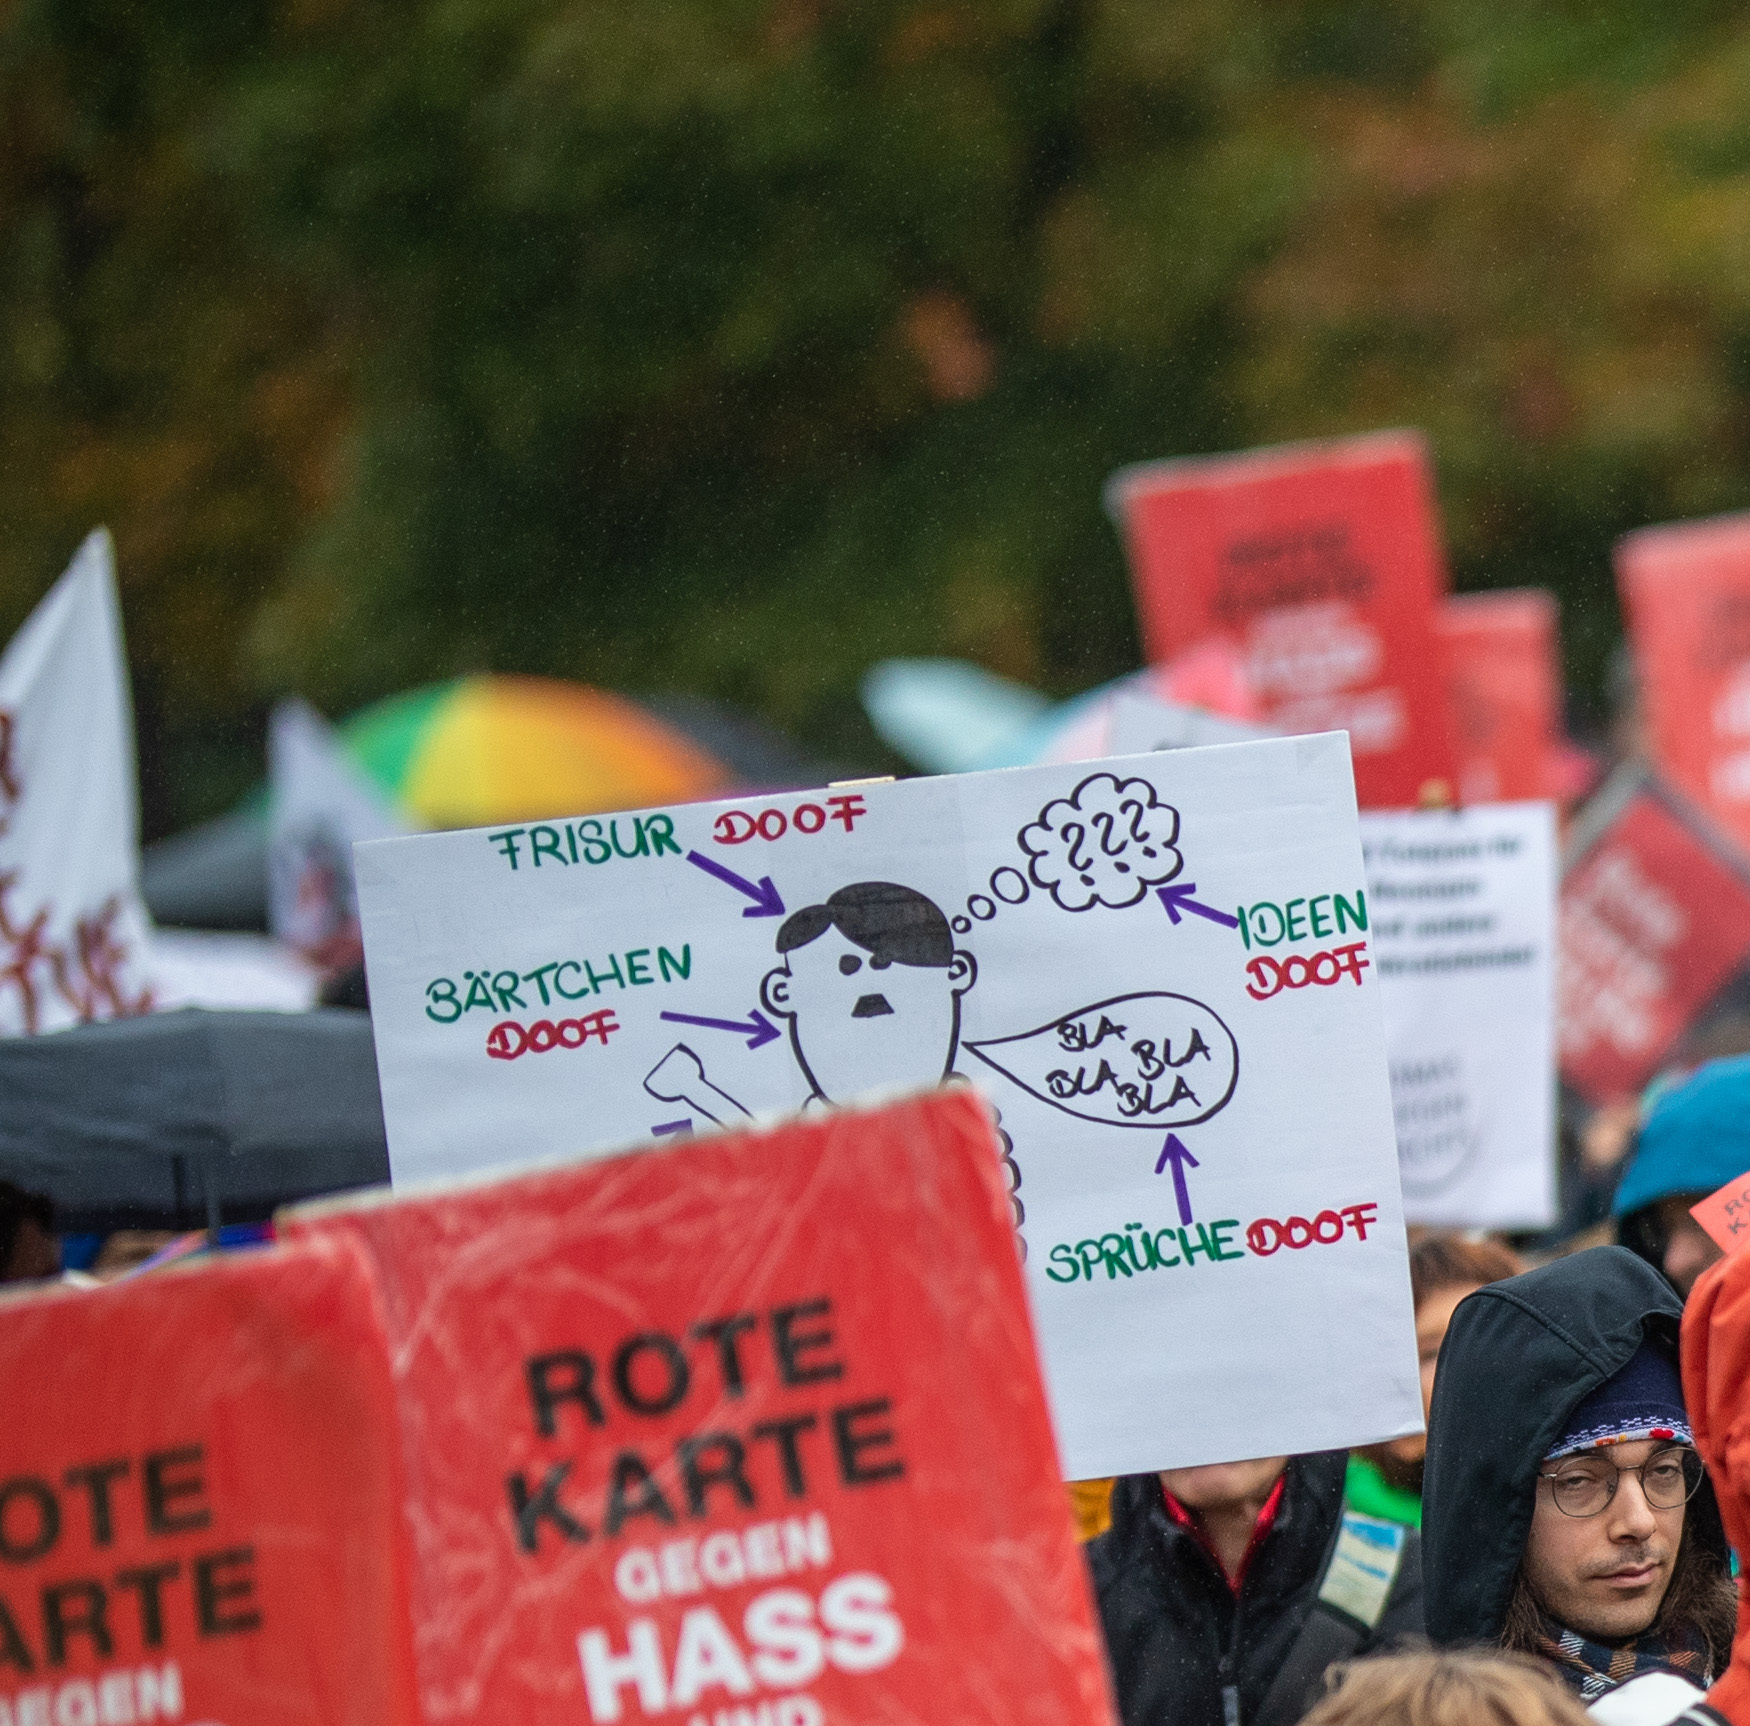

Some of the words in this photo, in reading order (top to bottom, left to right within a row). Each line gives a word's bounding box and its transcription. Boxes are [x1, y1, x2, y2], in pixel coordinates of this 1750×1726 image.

[487, 813, 683, 873] FRISUR
[712, 793, 866, 846] DOOF
[1235, 889, 1368, 950] IDEEN
[425, 943, 692, 1025] BÄRTCHEN
[1245, 941, 1371, 1001] DOOF
[486, 1008, 621, 1061] DOOF
[1054, 1014, 1126, 1053] BLA
[1132, 1027, 1213, 1081] BLA
[1044, 1057, 1117, 1102] BLA
[1116, 1074, 1201, 1118] BLA
[1044, 1215, 1245, 1285] SPRÜCHE
[1245, 1201, 1378, 1256] DOOF
[523, 1297, 849, 1441] ROTE
[0, 1441, 213, 1567] OTE
[505, 1397, 909, 1555] KARTE
[615, 1512, 834, 1605] GEGEN
[576, 1572, 904, 1726] HASS
